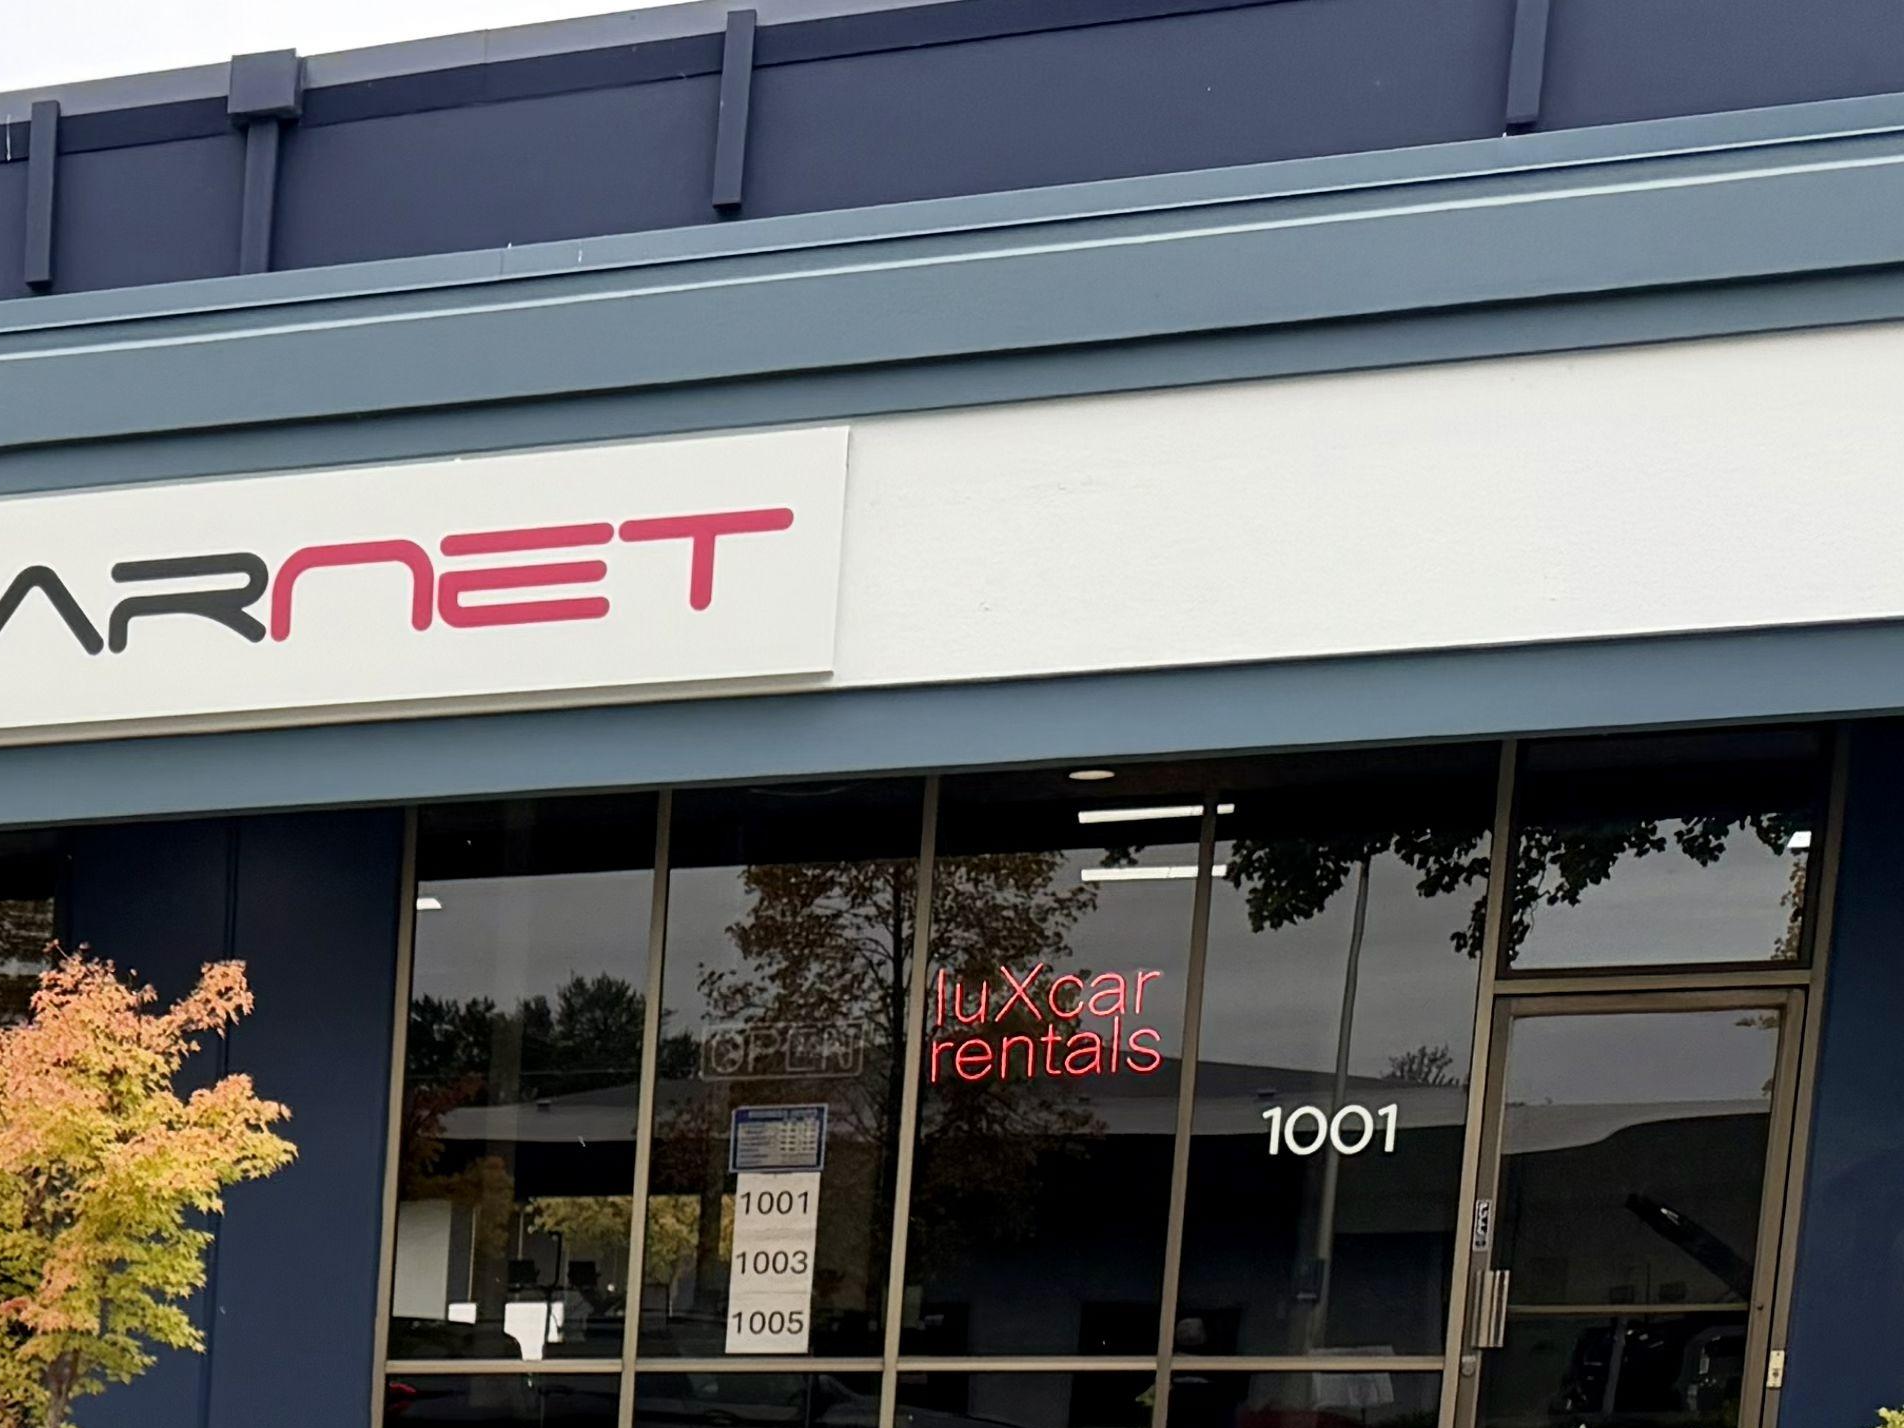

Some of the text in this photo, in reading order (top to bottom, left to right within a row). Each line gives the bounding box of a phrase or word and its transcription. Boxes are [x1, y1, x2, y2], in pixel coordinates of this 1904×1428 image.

[937, 962, 1162, 1026] luXcar
[711, 1027, 855, 1074] OPEN
[930, 1016, 1162, 1083] rentals
[1261, 1103, 1398, 1156] 1001
[740, 1190, 809, 1215] 1001
[735, 1250, 808, 1275] 1003
[732, 1311, 804, 1335] 1005
